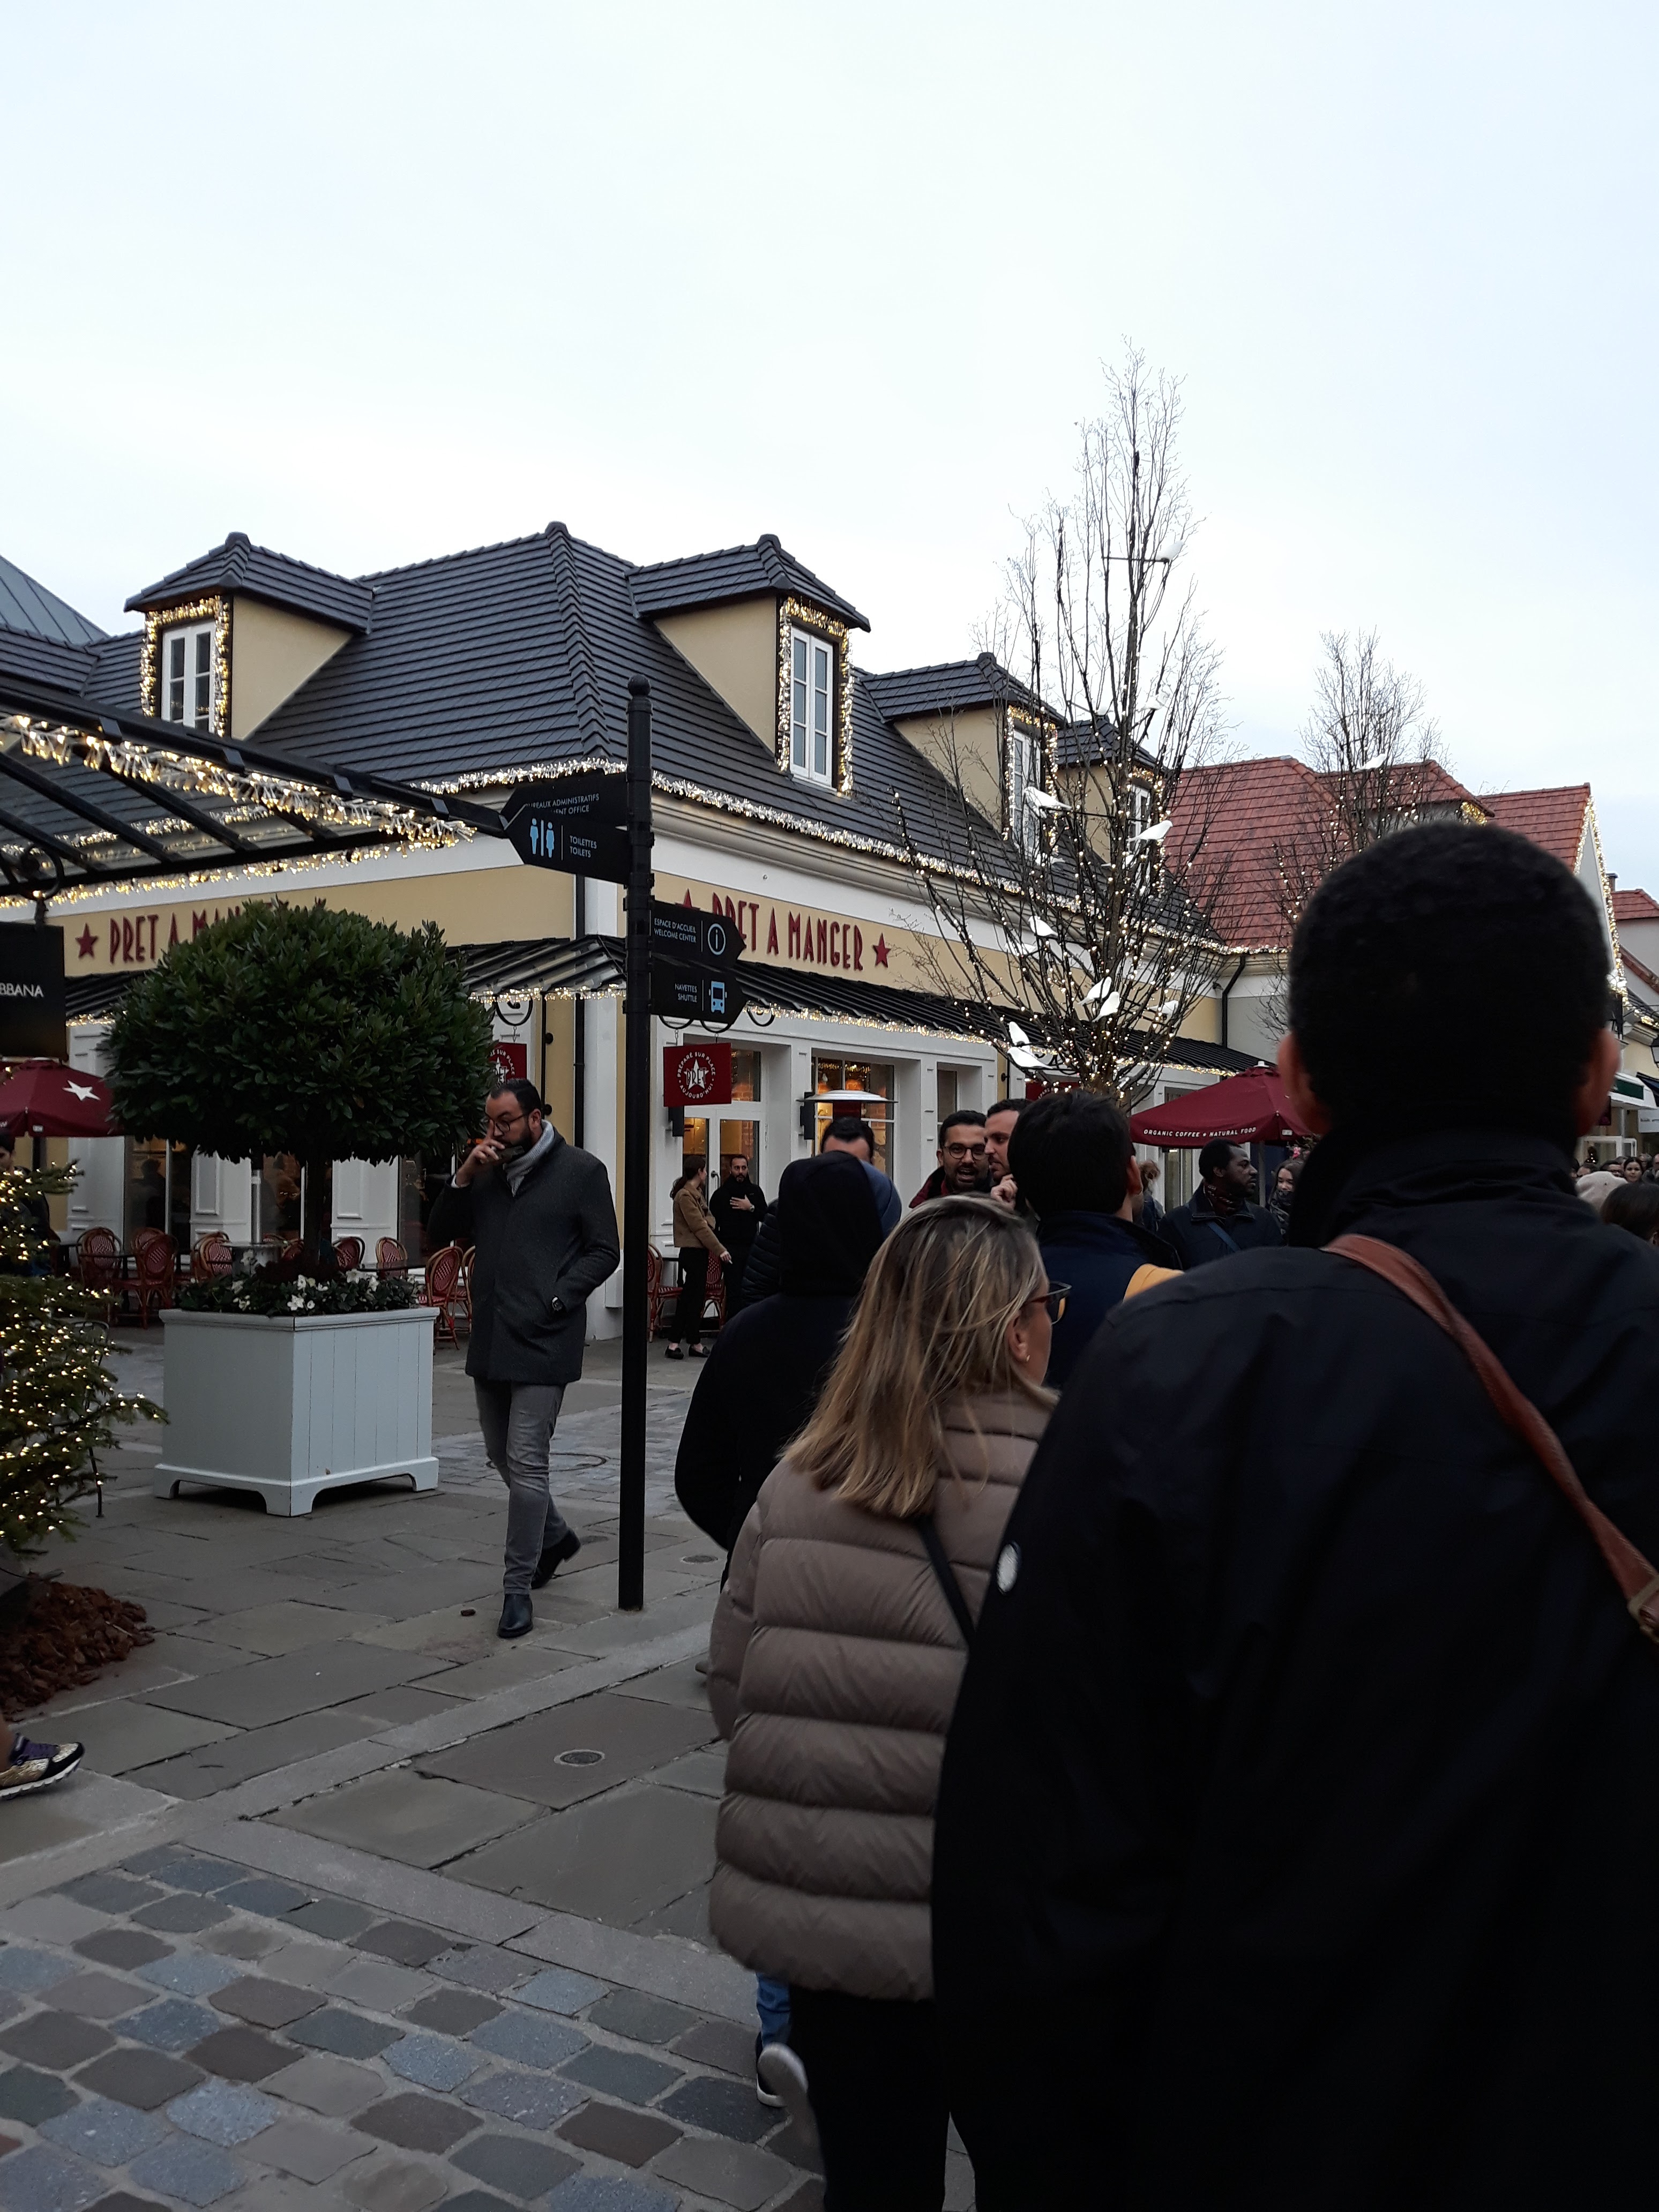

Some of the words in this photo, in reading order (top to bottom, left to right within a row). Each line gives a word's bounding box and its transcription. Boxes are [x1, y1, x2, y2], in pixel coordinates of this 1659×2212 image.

[552, 793, 600, 806] ADMINISTRATIFS
[568, 804, 589, 814] OFFICE
[570, 835, 597, 849] TOILETTES
[570, 846, 591, 858] TOILETS
[654, 917, 671, 928] ESPACE
[110, 914, 159, 965] PRET
[654, 928, 678, 940] WELCOME
[679, 933, 697, 943] CENTER
[767, 906, 779, 955] A
[788, 910, 863, 971] MANGER
[675, 983, 697, 993] NAVETTES
[677, 993, 697, 1003] SHUTTLE
[706, 1056, 716, 1076] PLACE
[686, 1067, 707, 1086] PRET
[679, 1083, 714, 1099] AUJOURD'HUI
[1144, 1129, 1173, 1137] ORGANIC
[1175, 1129, 1200, 1138] COFFEE
[1209, 1129, 1238, 1138] NATURAL
[1240, 1126, 1257, 1134] FOOD
